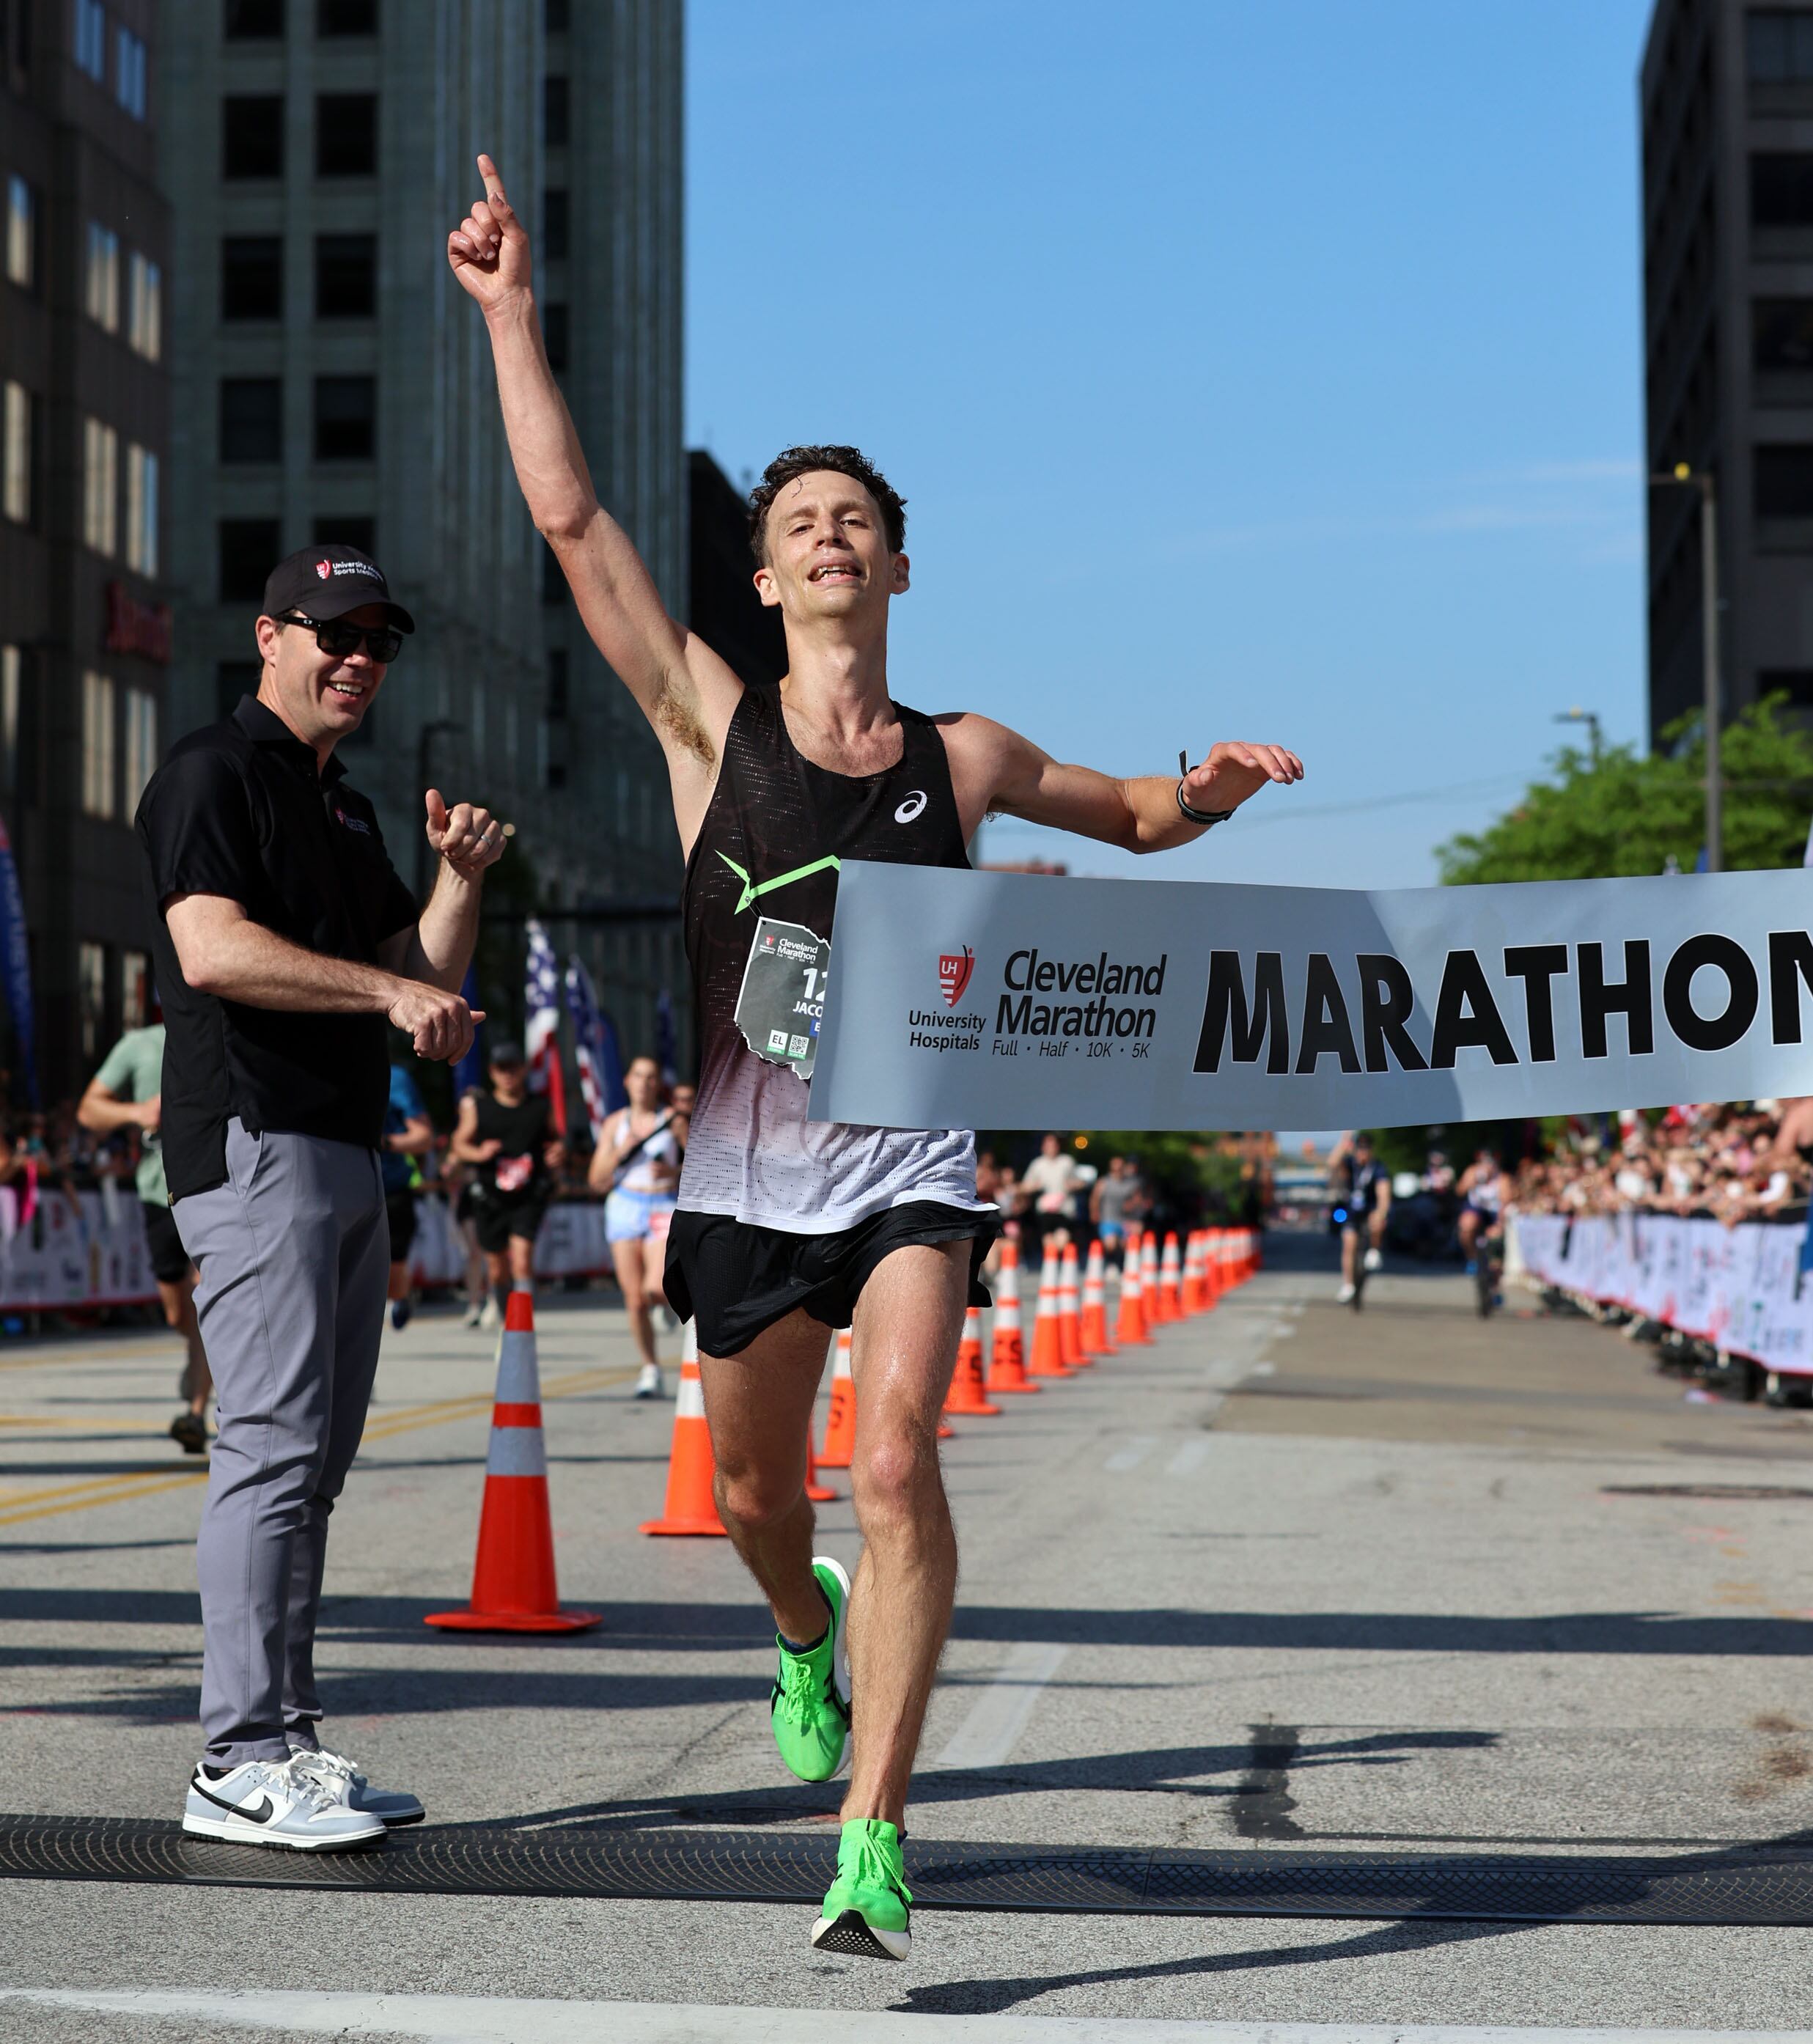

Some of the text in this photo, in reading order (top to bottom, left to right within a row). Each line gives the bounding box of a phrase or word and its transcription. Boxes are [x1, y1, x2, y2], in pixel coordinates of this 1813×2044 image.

[332, 562, 366, 570] University
[334, 567, 356, 576] Sports
[777, 946, 816, 961] Marathon
[779, 938, 818, 954] Cleveland
[941, 961, 957, 974] UH
[1004, 949, 1167, 996] Cleveland
[793, 1001, 823, 1018] JACO
[995, 994, 1157, 1038] Marathon
[908, 1010, 986, 1033] University
[772, 1034, 784, 1045] EL
[909, 1032, 980, 1052] Hospitals
[992, 1040, 1150, 1059] Full Half 10K 5K
